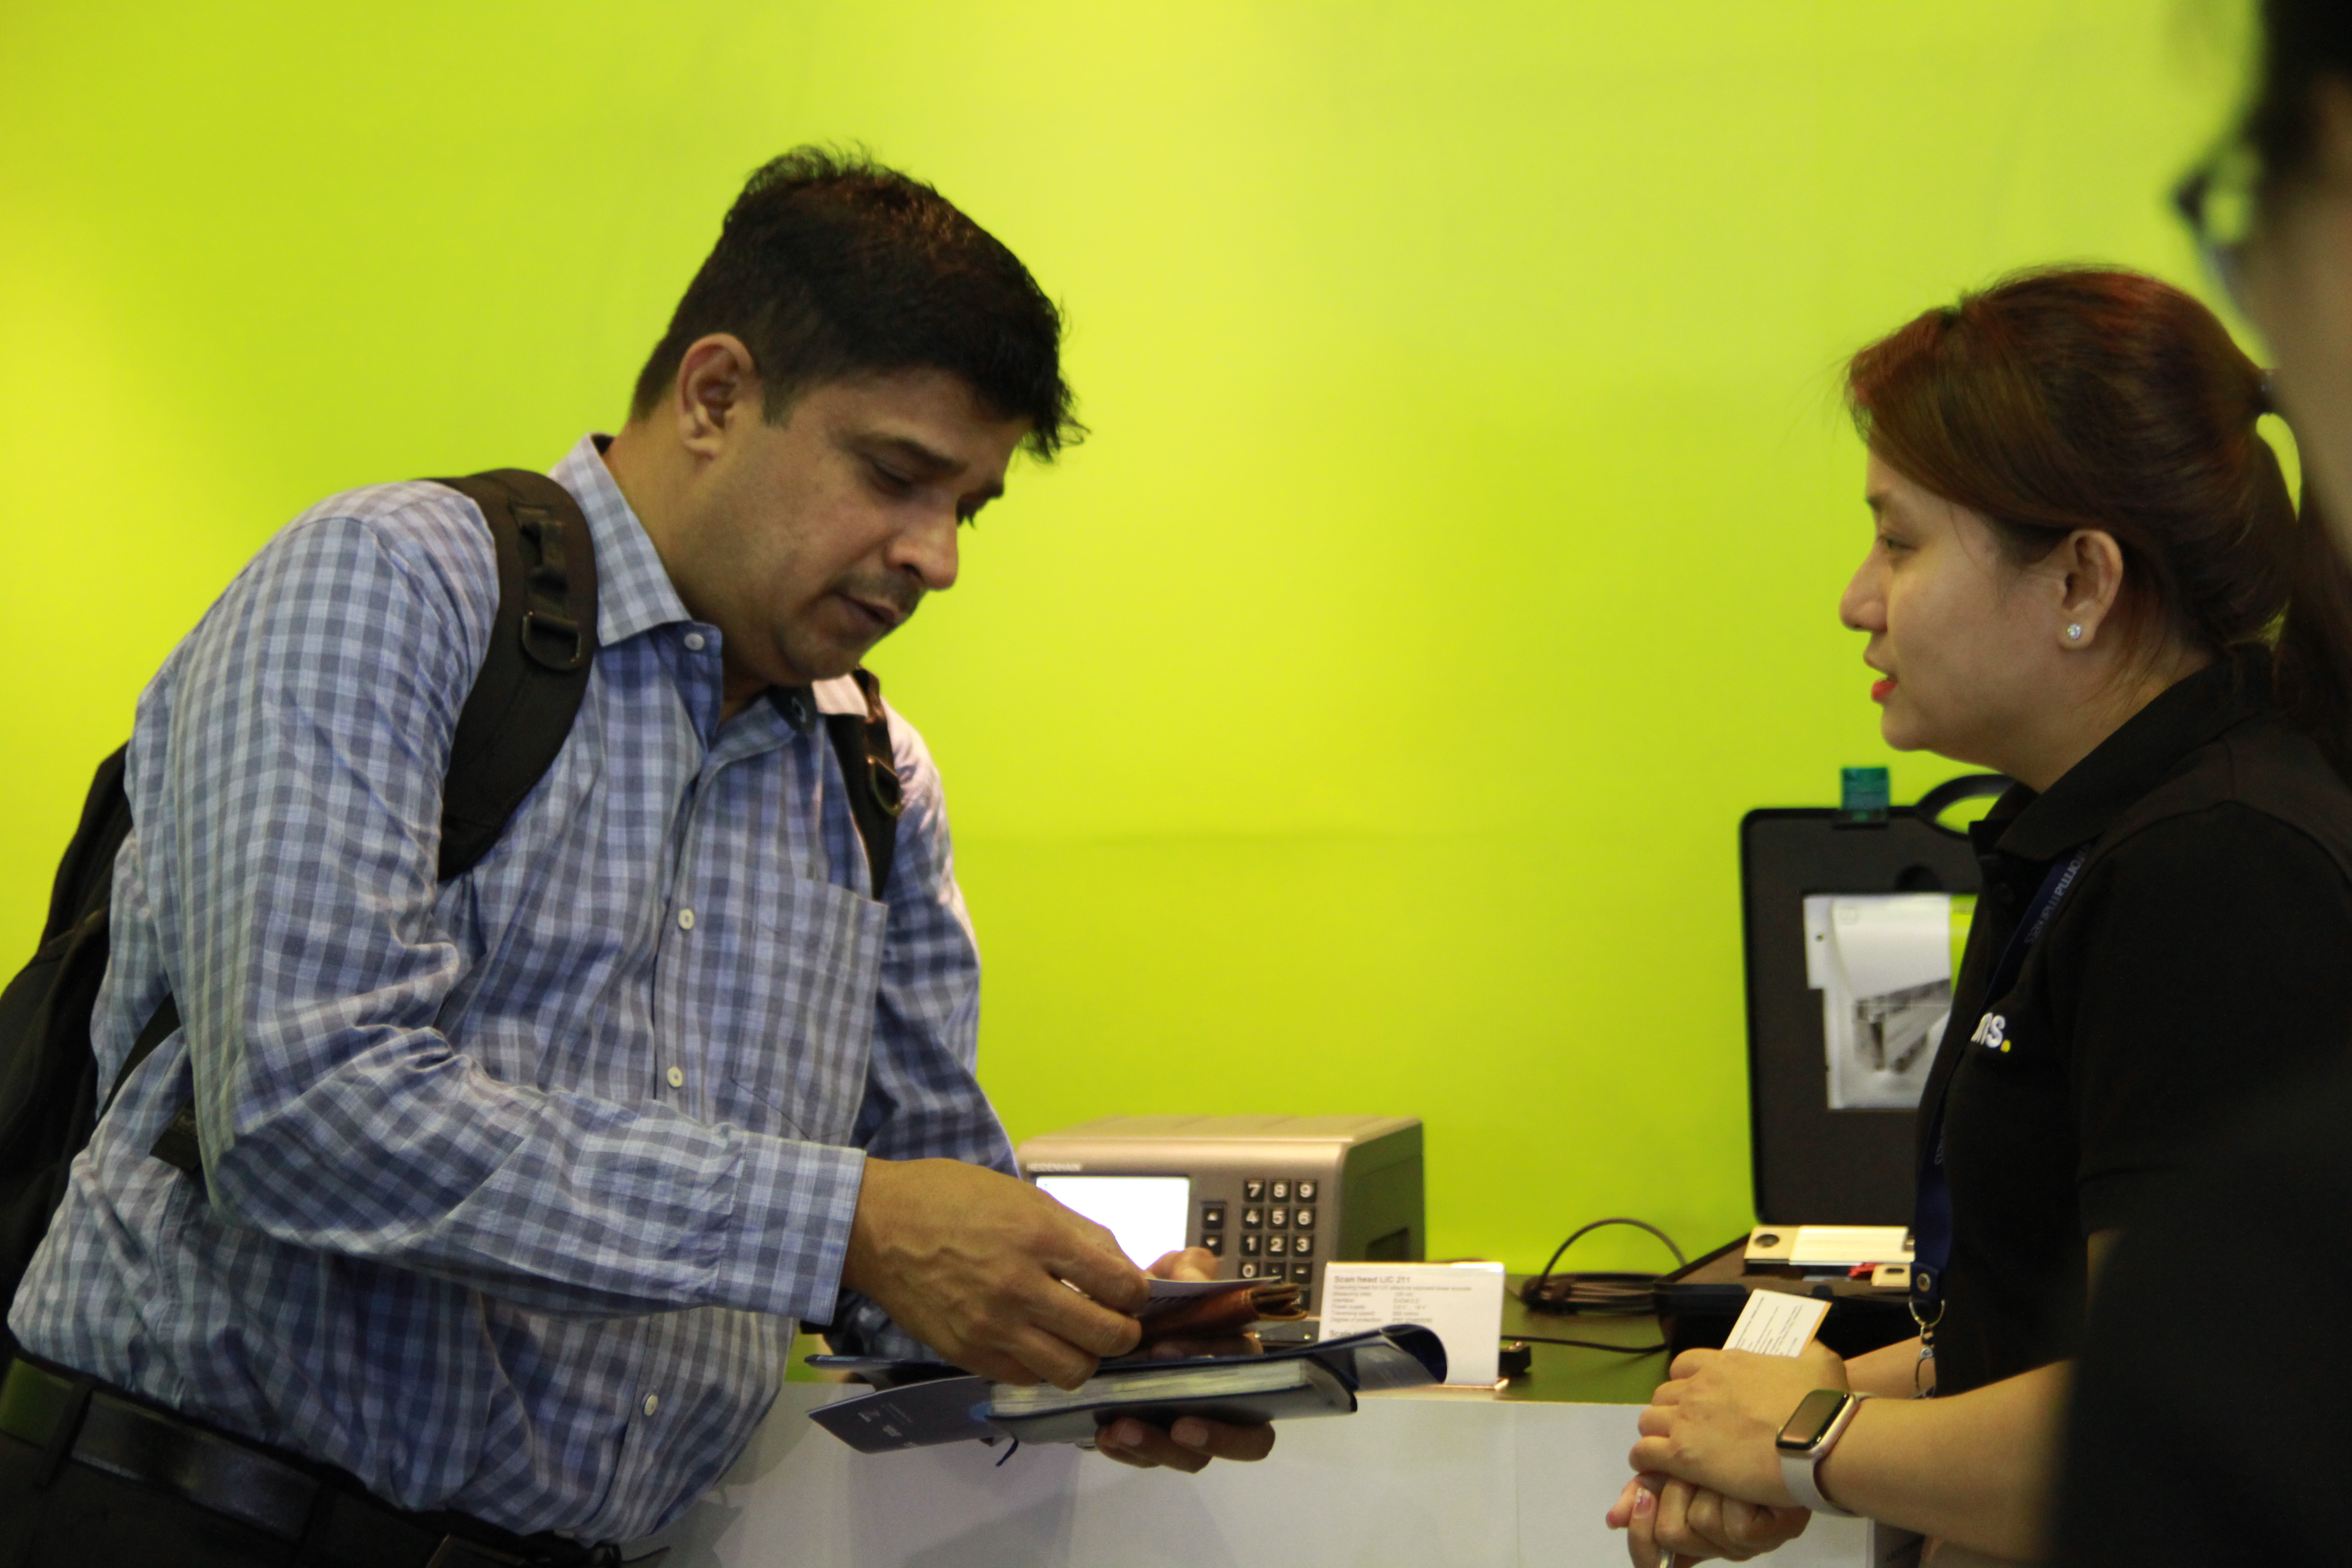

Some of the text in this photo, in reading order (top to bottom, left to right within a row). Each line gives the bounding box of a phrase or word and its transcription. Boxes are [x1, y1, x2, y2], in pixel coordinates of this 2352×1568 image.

[1248, 1183, 1314, 1198] 7 8 9
[1245, 1210, 1313, 1225] 4 5 6
[1246, 1236, 1310, 1253] 1 2 3
[1242, 1264, 1257, 1278] 0
